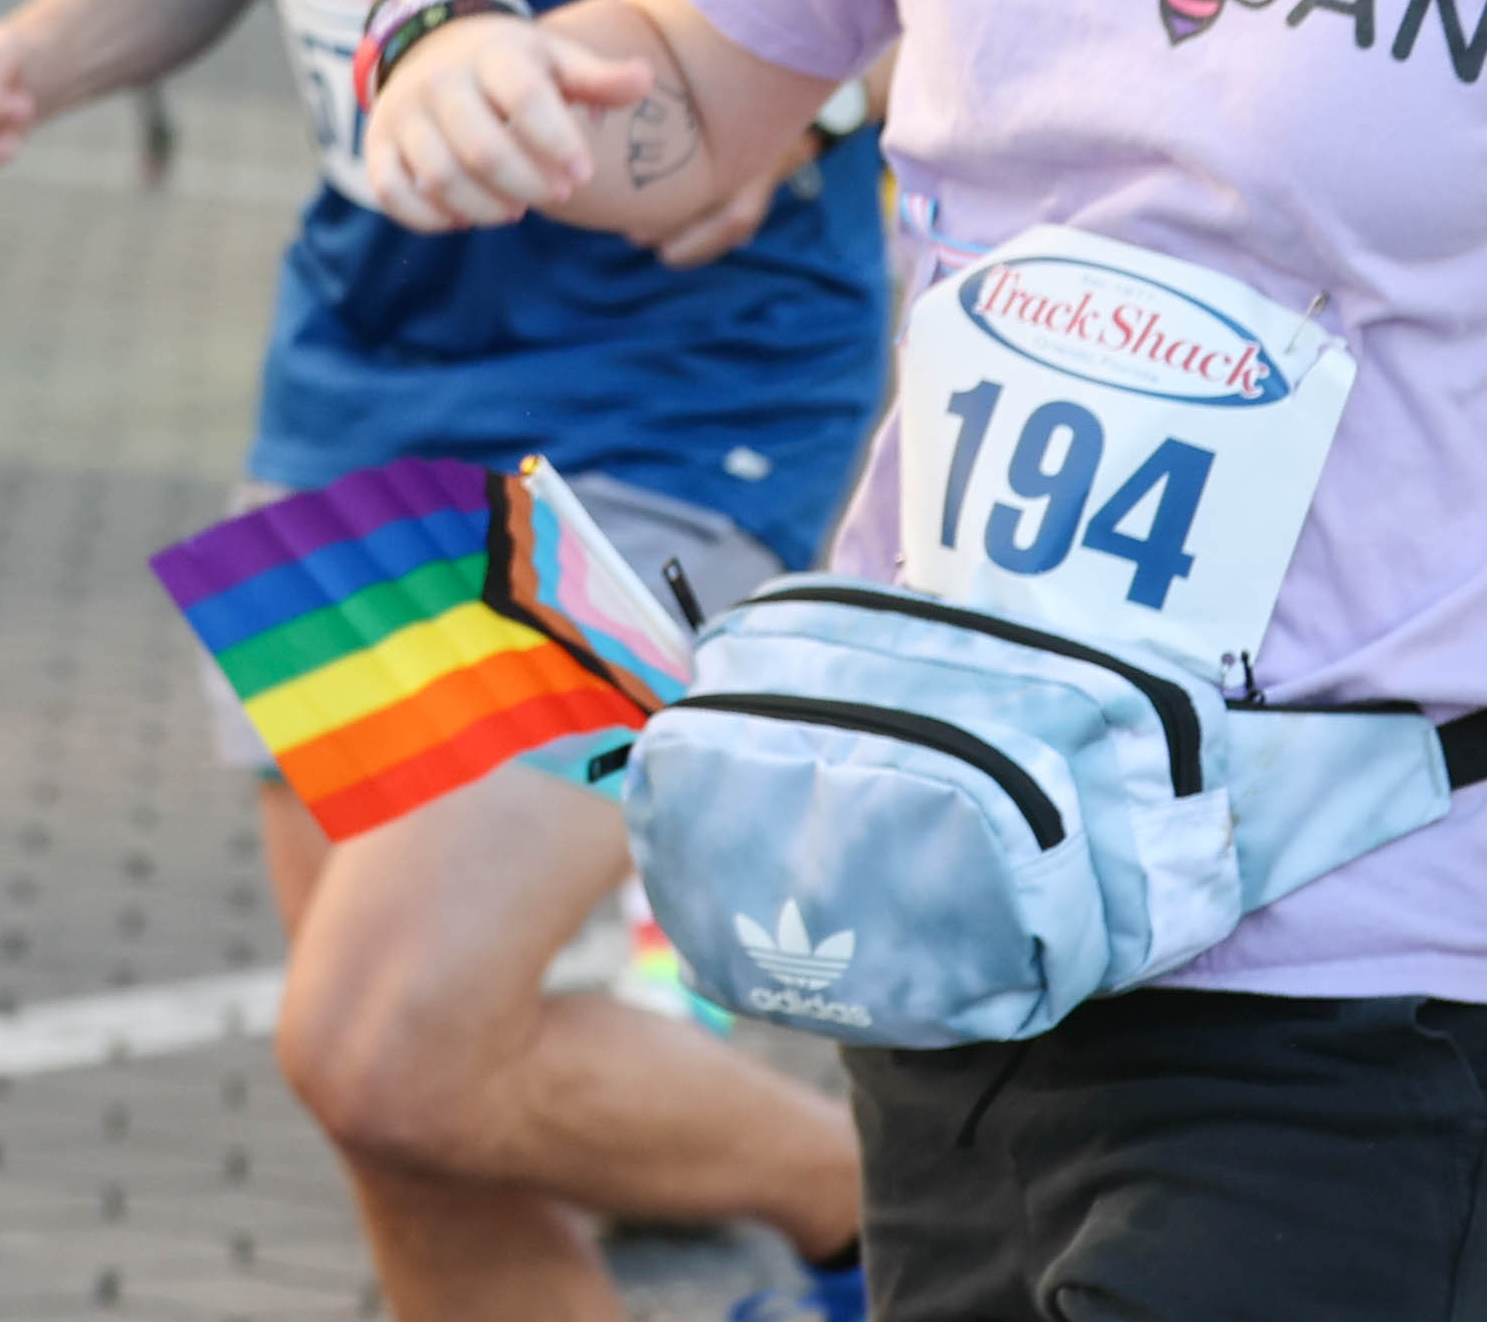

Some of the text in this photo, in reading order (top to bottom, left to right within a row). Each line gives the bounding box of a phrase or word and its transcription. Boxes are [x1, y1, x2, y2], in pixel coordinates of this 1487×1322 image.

[970, 261, 1099, 341] Track
[1098, 302, 1270, 398] Shack
[940, 379, 1216, 611] 194
[749, 987, 873, 1029] adidas
